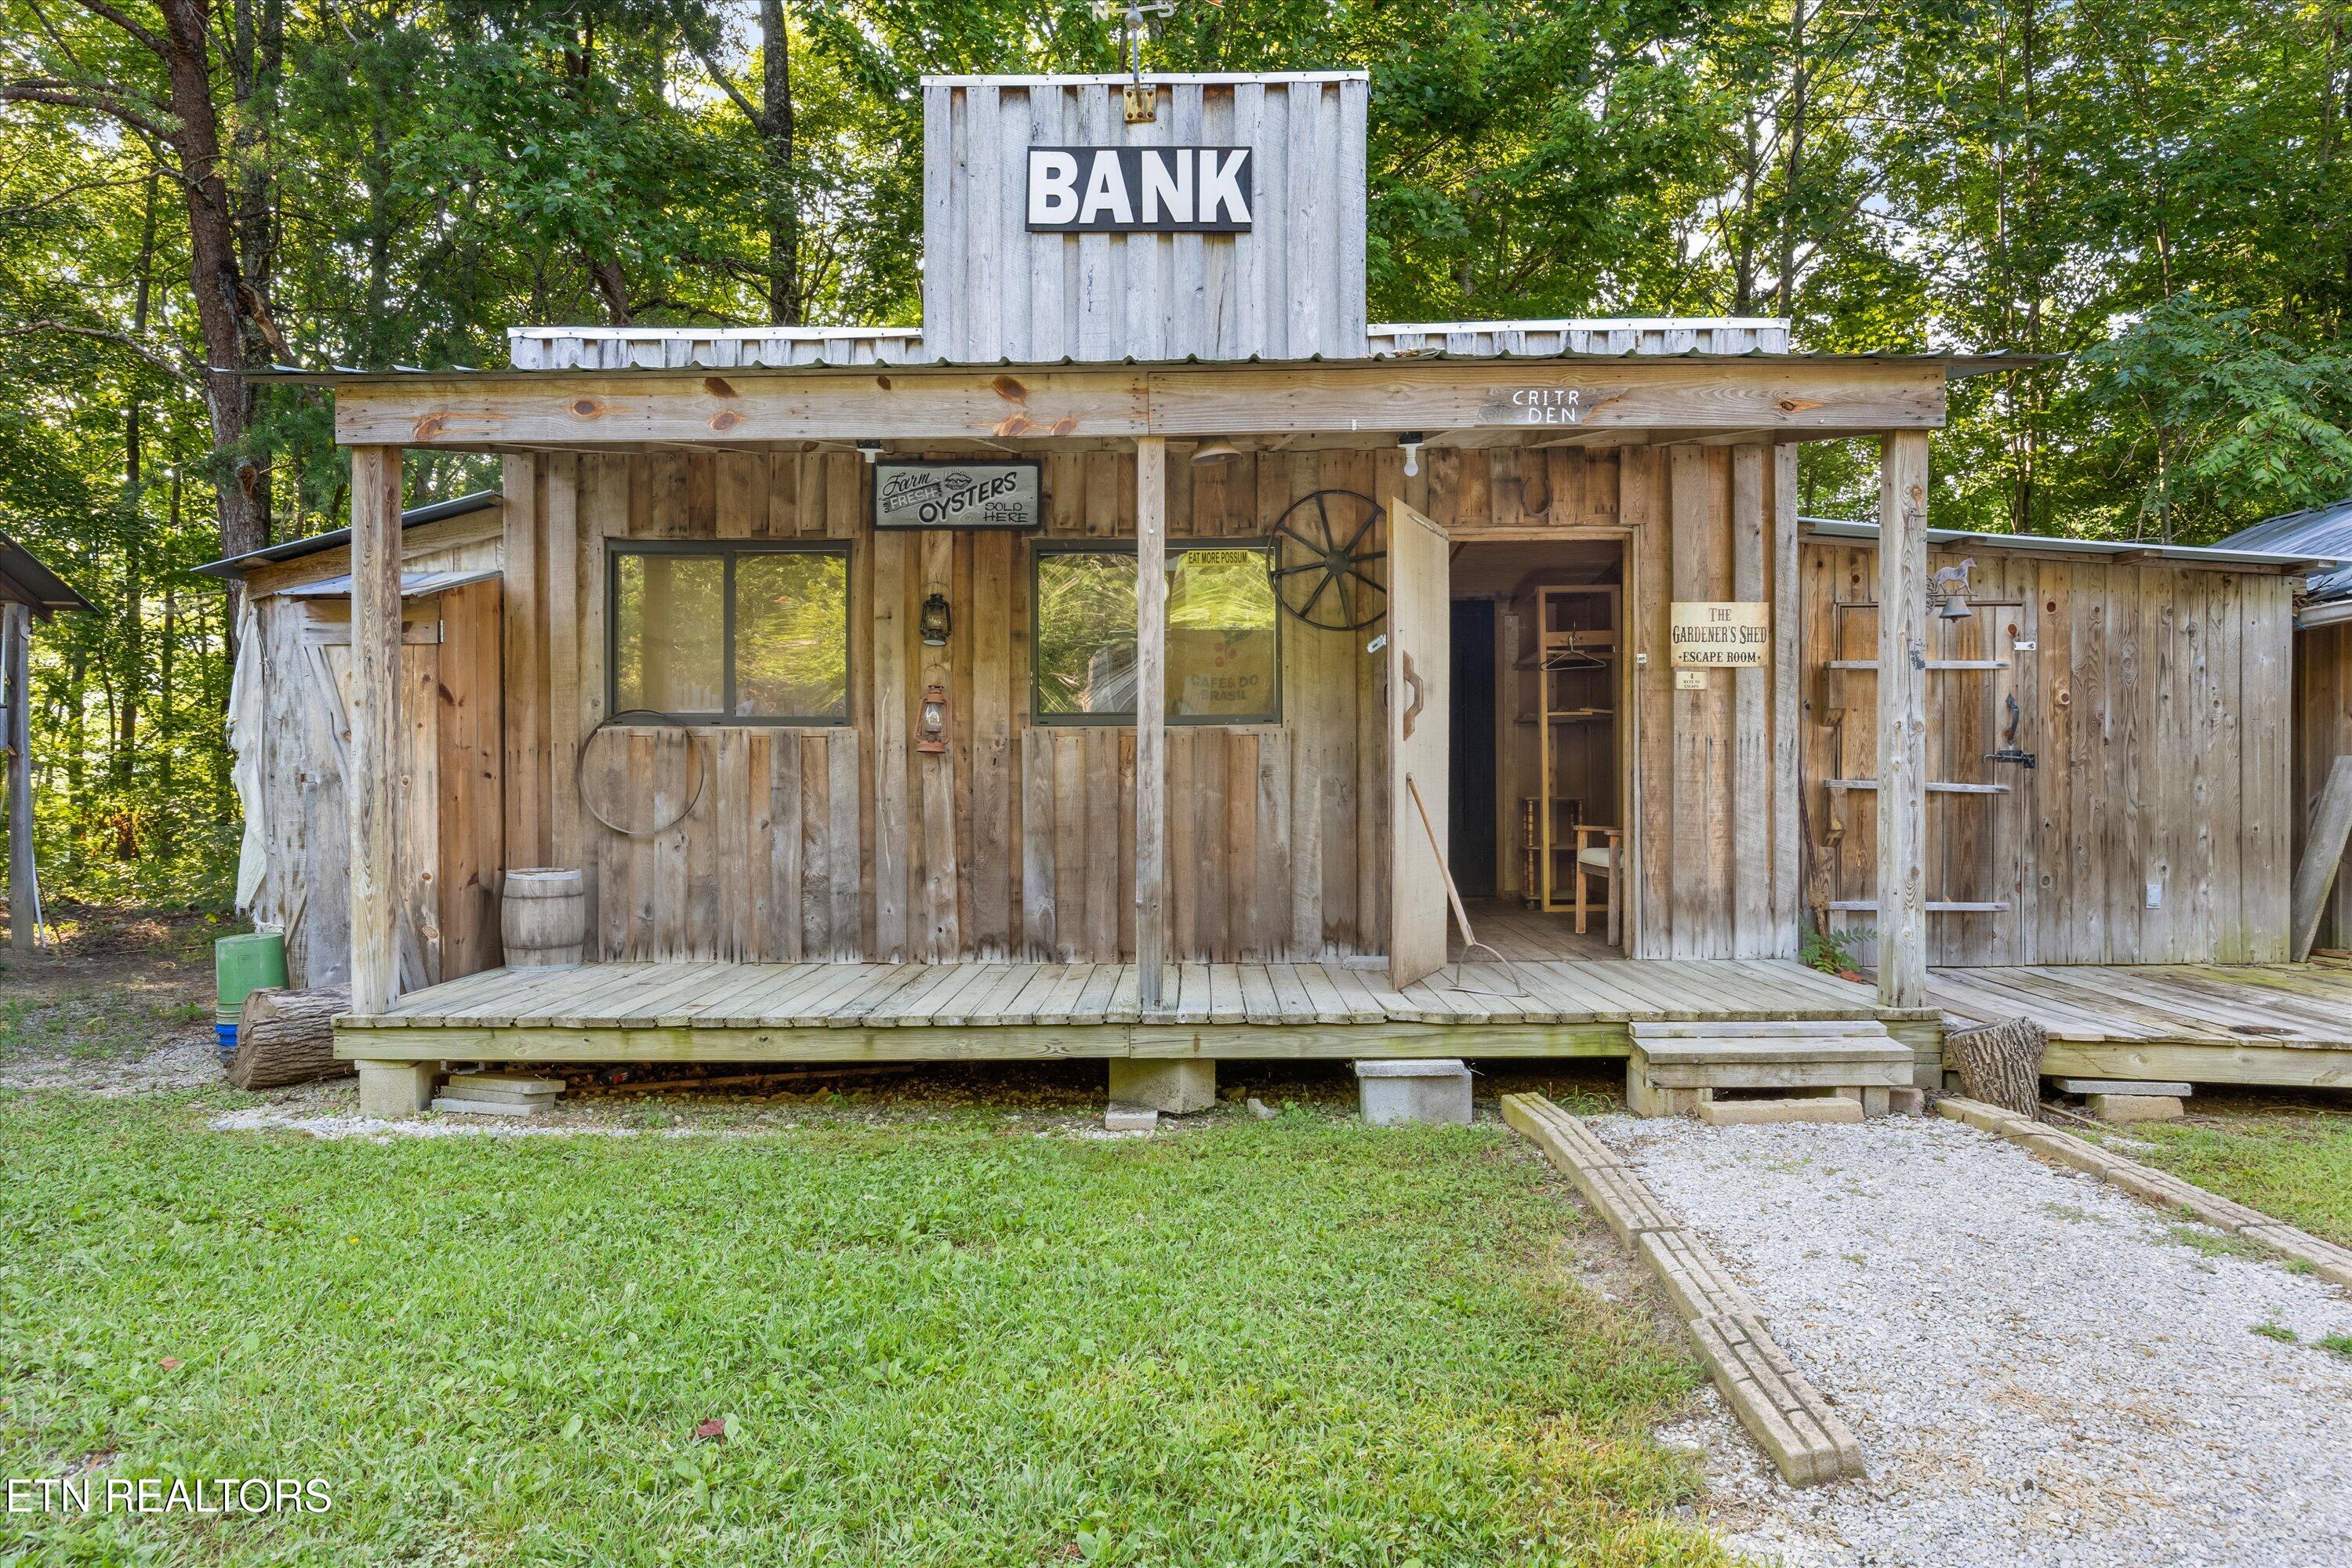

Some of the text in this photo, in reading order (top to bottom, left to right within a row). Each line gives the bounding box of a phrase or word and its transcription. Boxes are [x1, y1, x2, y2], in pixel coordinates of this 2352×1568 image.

[1029, 149, 1252, 224] BANK
[1512, 390, 1579, 405] CRITR
[1529, 407, 1576, 423] DEN
[883, 472, 931, 496] Farm
[889, 487, 938, 509] FRESH
[918, 471, 1018, 523] OYSTERS
[985, 502, 1023, 511] SOLD
[983, 512, 1029, 523] HERE
[1189, 551, 1247, 564] EAT MORE POSSUM
[1708, 608, 1732, 622] THE
[1672, 625, 1767, 644] GARDENER'S SHED
[1682, 652, 1756, 662] ESCAPE ROOM
